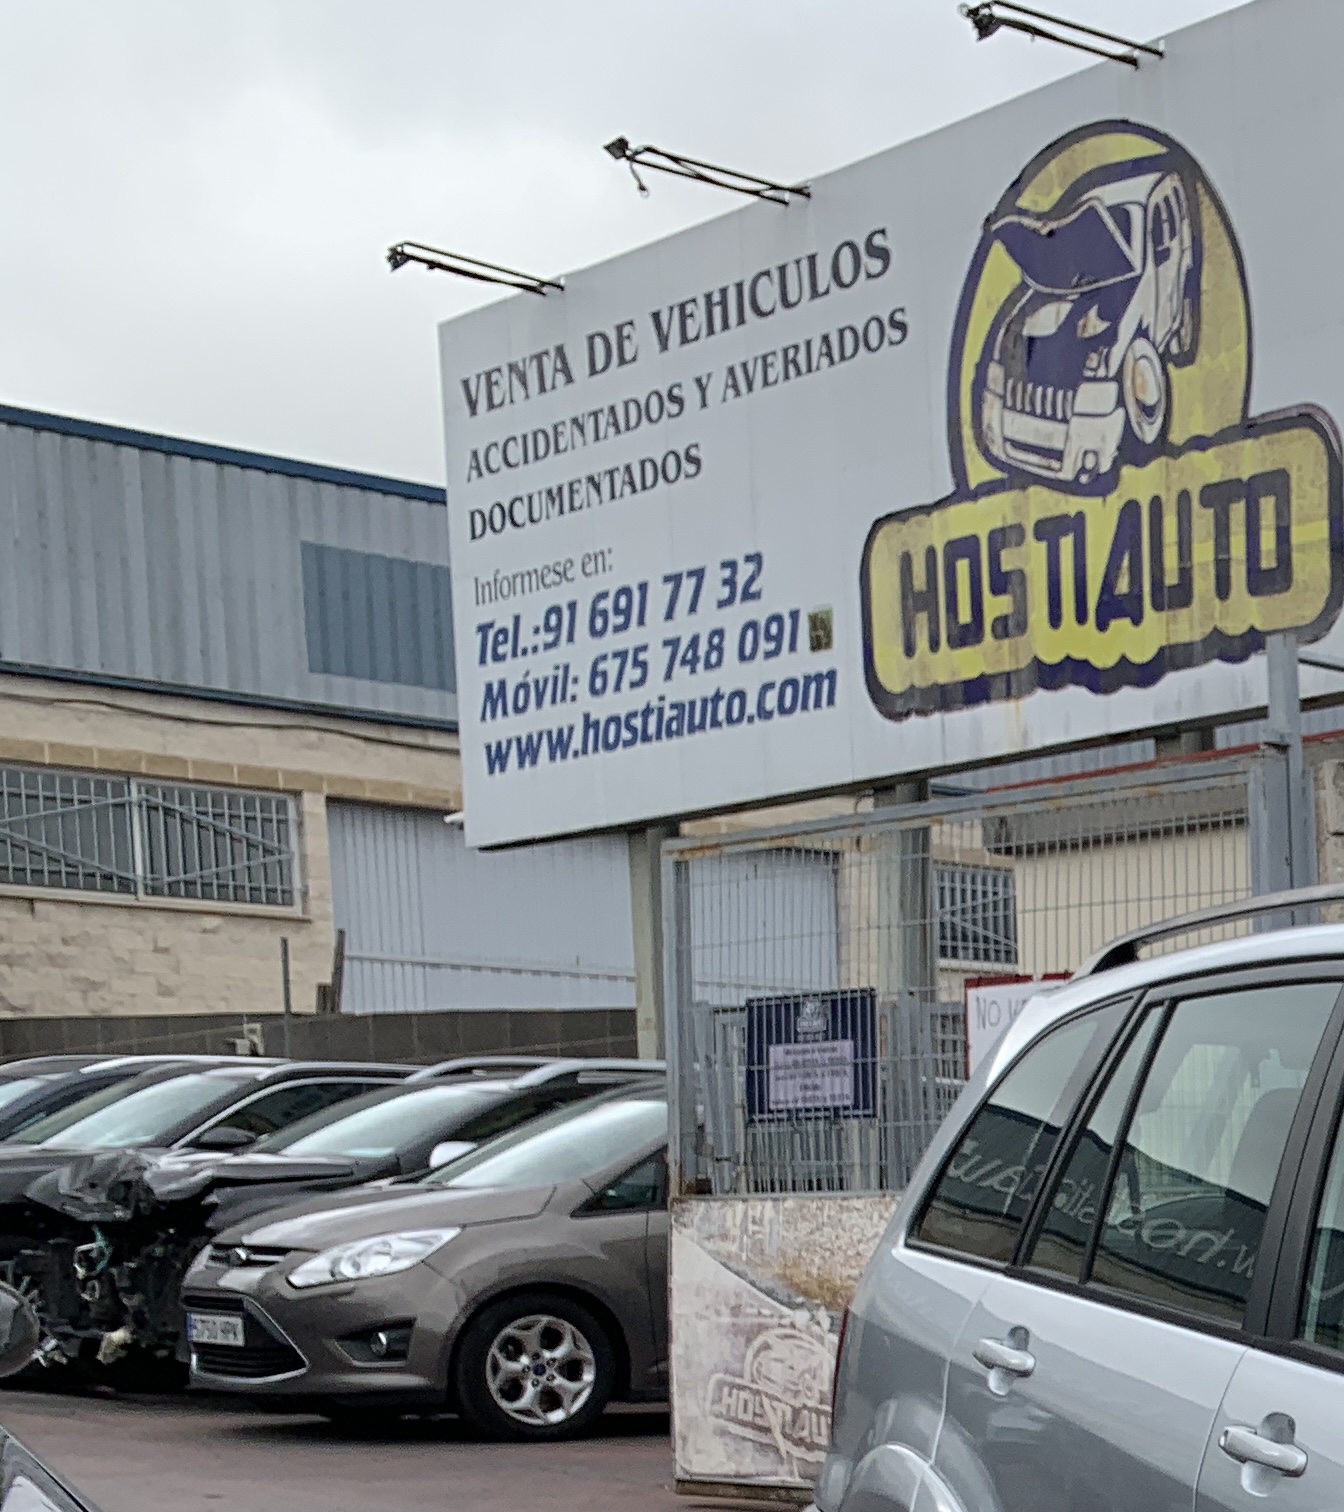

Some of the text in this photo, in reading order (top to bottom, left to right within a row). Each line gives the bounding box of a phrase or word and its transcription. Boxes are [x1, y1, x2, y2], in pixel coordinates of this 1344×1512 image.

[461, 228, 892, 418] VENTA DE VEHICULOS
[466, 306, 909, 482] ACCIDENTADOS Y AVERIADOS
[469, 443, 701, 542] DOCUMENTADOS
[581, 547, 614, 581] en:
[588, 581, 649, 640] 691
[662, 567, 707, 622] 77
[716, 552, 764, 610] 32
[900, 468, 1292, 659] HOSTIAUTO
[480, 608, 800, 722] Móvil: 675 748 091
[485, 668, 838, 776] www.hostiauto.com
[975, 995, 1001, 1030] NO
